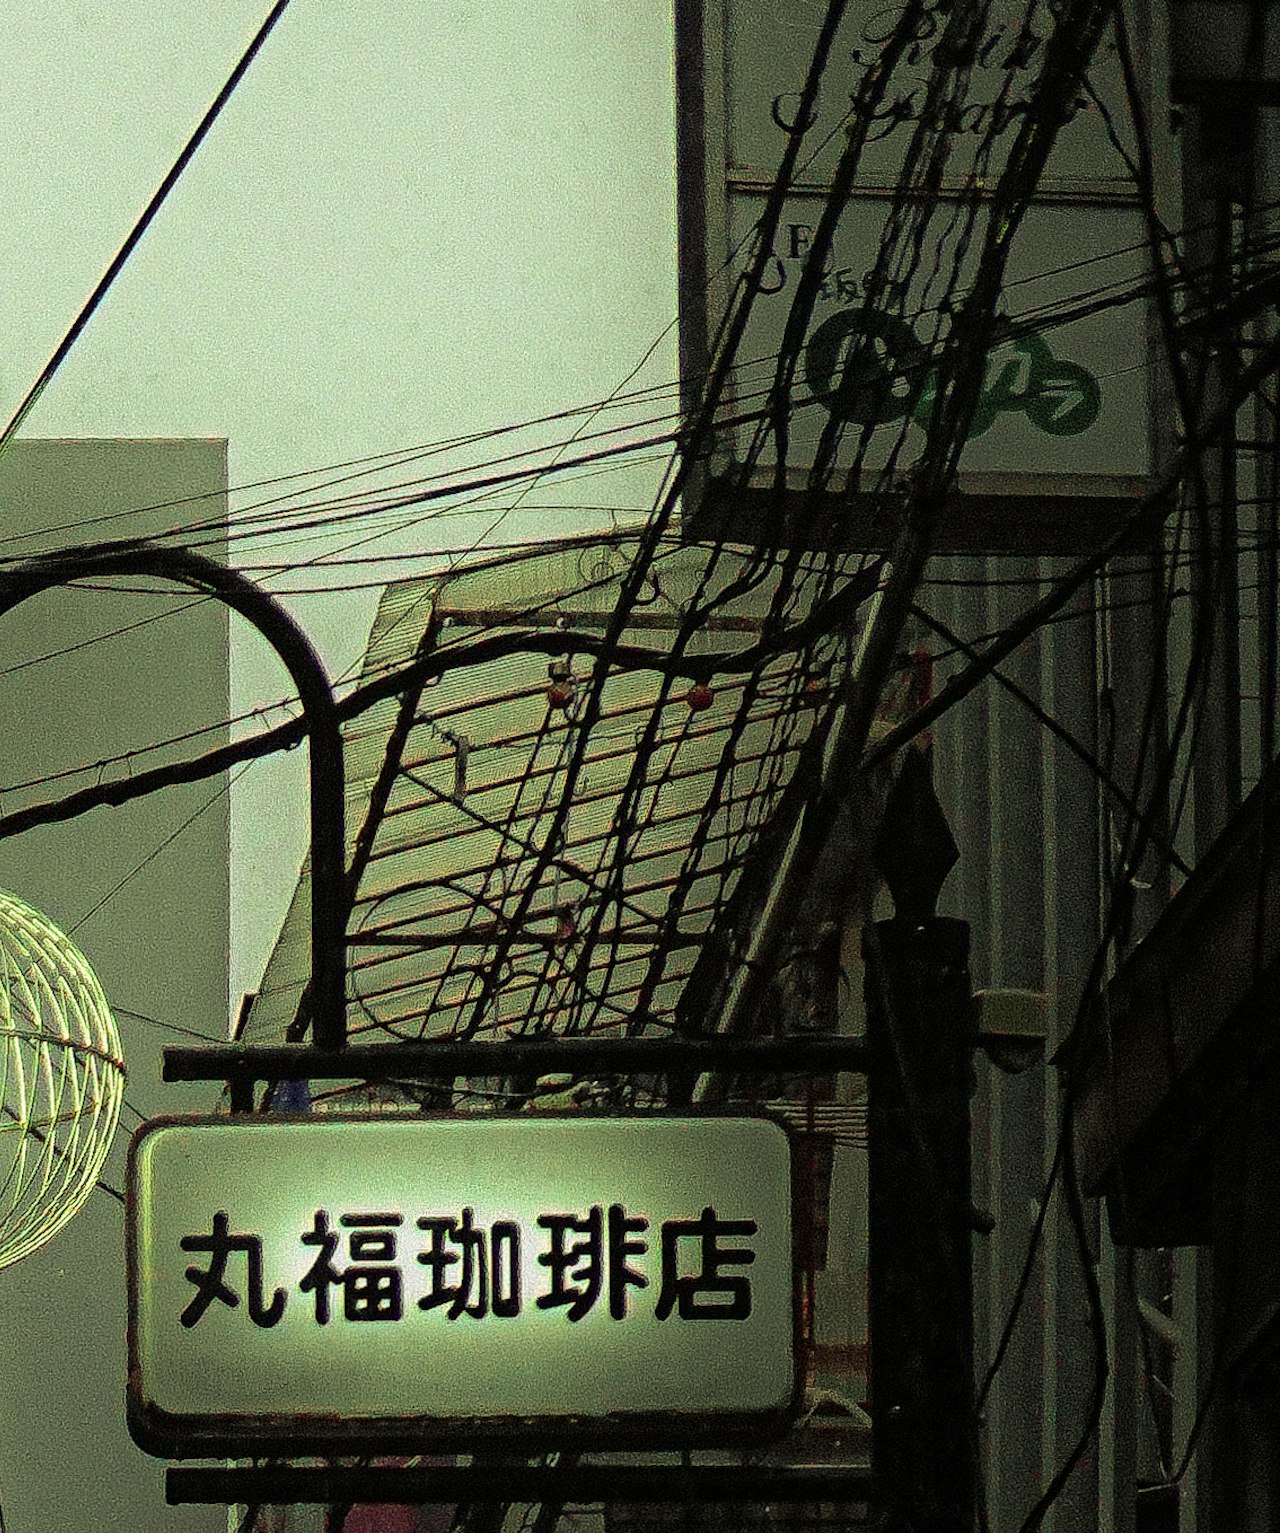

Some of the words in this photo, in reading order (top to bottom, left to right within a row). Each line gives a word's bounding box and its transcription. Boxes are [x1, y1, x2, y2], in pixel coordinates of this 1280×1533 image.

[180, 1204, 758, 1328] 丸福珈琲店
